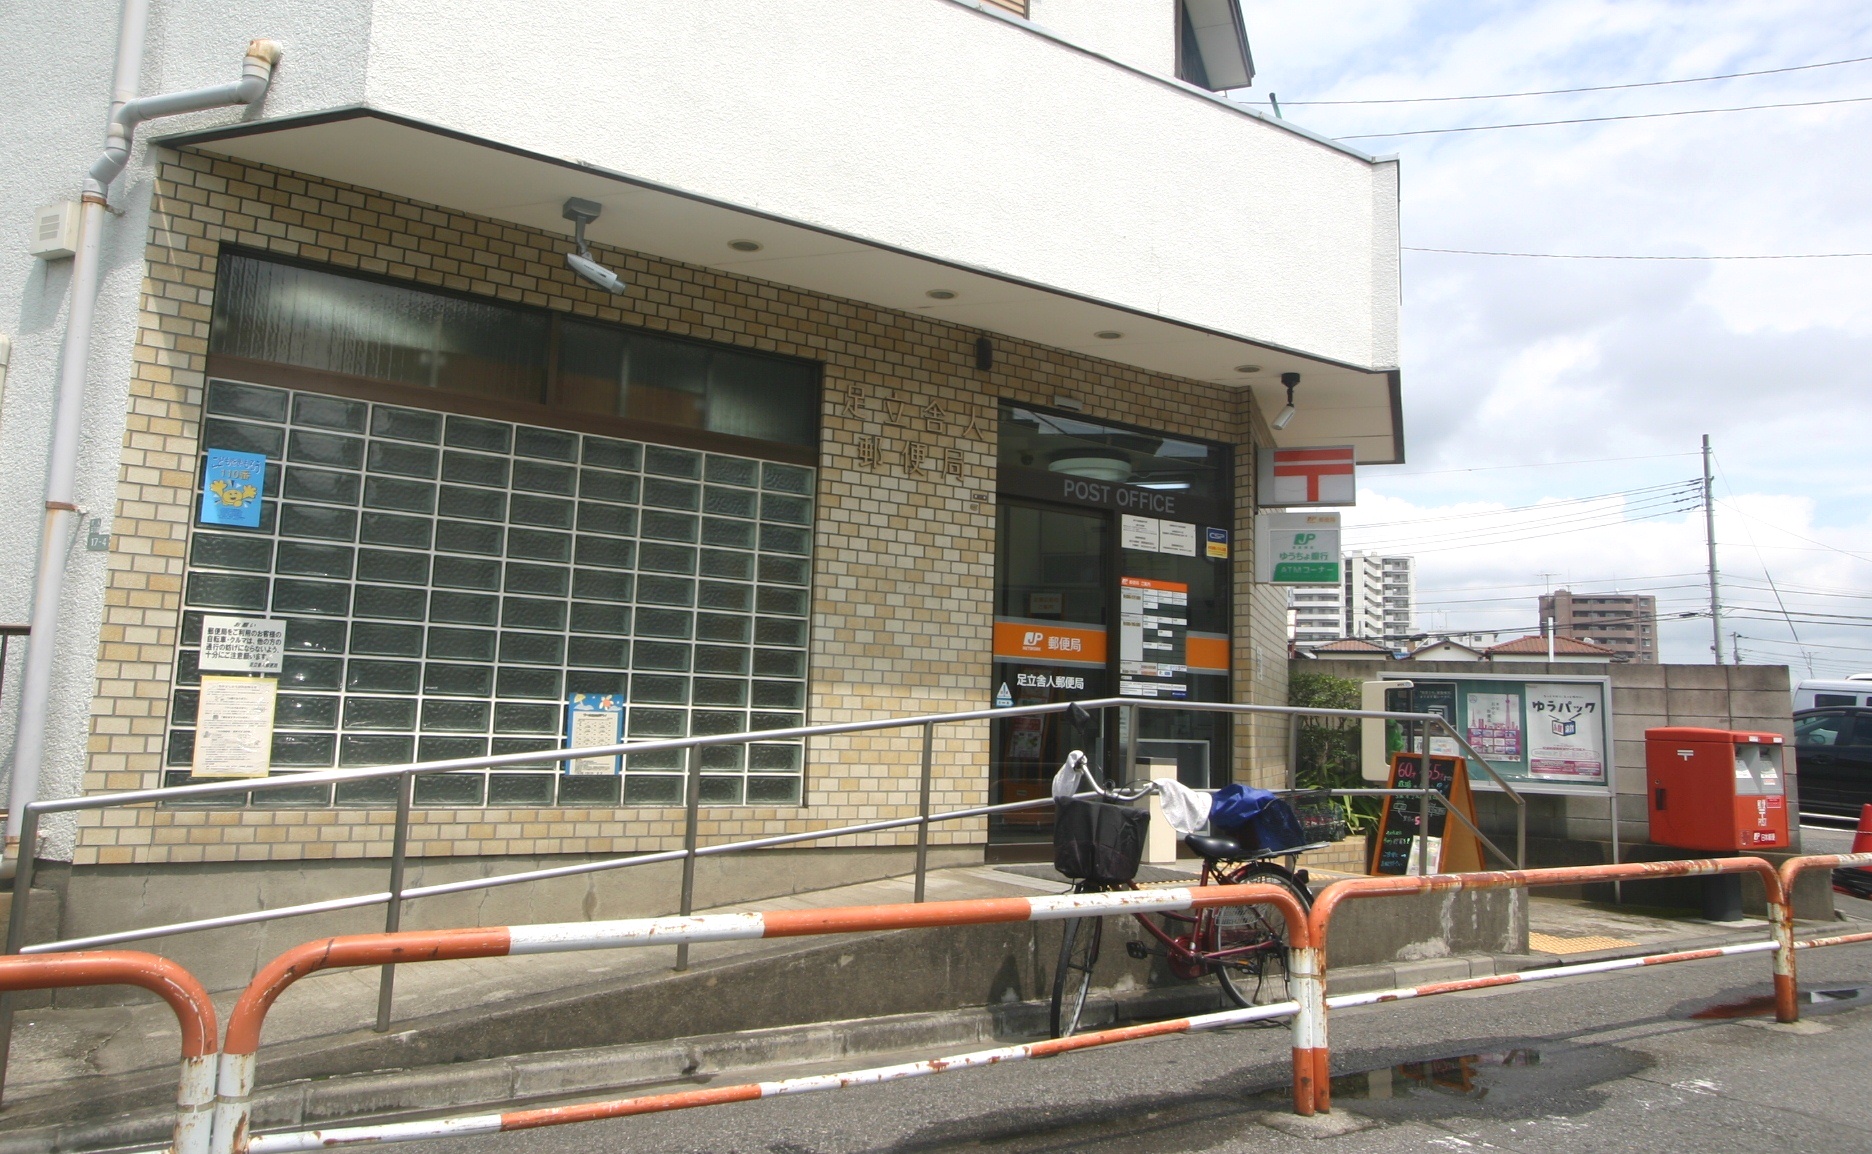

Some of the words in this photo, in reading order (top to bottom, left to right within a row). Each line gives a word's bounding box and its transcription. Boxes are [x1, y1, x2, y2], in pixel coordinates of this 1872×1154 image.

[842, 384, 984, 440] 足立舎人
[858, 436, 964, 482] 郵便局
[221, 469, 251, 480] 110番
[1063, 479, 1111, 503] POST
[1116, 488, 1175, 514] OFFICE
[91, 537, 107, 547] 17-4
[1294, 533, 1316, 546] JP
[1279, 551, 1328, 561] ゆうちょ銀行
[1281, 566, 1334, 574] ATMコーナー
[207, 627, 282, 638] 郵便局をご利用のお客様の
[1023, 631, 1044, 646] JP
[1047, 636, 1081, 653] 郵便局
[1016, 673, 1085, 690] 足立舎人郵便局
[1532, 700, 1596, 713] ゆうパック
